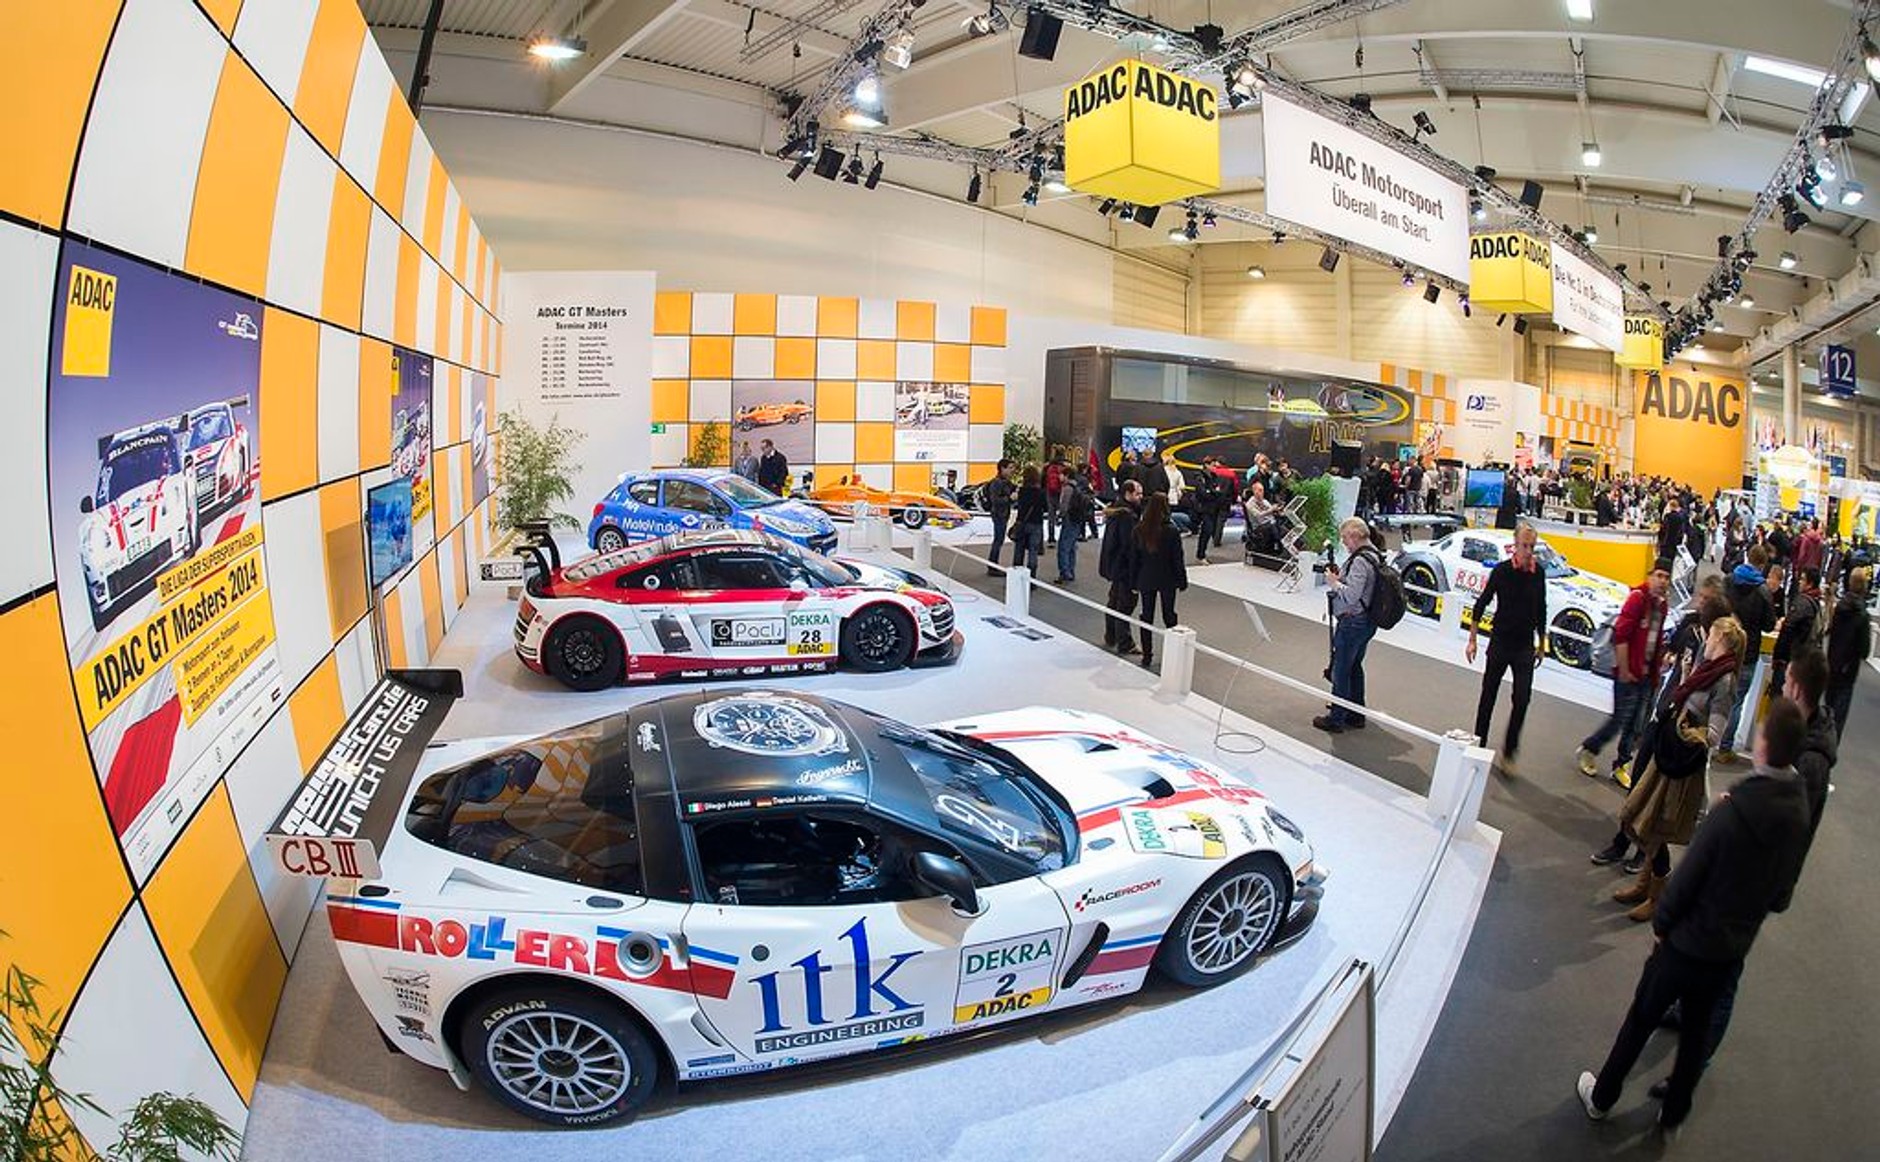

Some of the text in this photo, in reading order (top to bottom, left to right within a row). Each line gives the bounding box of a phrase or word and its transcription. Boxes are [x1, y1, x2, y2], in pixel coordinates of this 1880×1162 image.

[1066, 66, 1128, 122] ADAC
[1134, 67, 1216, 122] ADAC
[1309, 140, 1444, 221] ADAC Motorsport
[1331, 182, 1432, 243] Überall am Start.
[1470, 235, 1520, 260] ADAC
[1523, 238, 1550, 270] ADAC
[71, 271, 113, 312] ADAC
[537, 306, 628, 318] ADAC GT Masters
[587, 321, 608, 330] 2014
[1624, 319, 1651, 336] DAC
[1831, 352, 1854, 382] 12
[1641, 374, 1741, 428] ADAC
[92, 557, 258, 710] ADAC GT Masters 2014
[791, 613, 830, 626] DEKRA
[801, 629, 822, 644] 28
[797, 643, 824, 655] ADAC
[374, 733, 402, 762] US
[392, 695, 429, 735] CARS
[1131, 810, 1166, 850] DEKRA
[1085, 879, 1163, 906] RACEROOM
[400, 915, 591, 975] ROLLER
[966, 938, 1052, 975] DEKRA
[748, 916, 925, 1035] itk
[995, 972, 1017, 996] 2
[482, 1000, 547, 1032] ADVAN
[971, 993, 1033, 1021] ADAC
[760, 1015, 920, 1051] ENGINEERING
